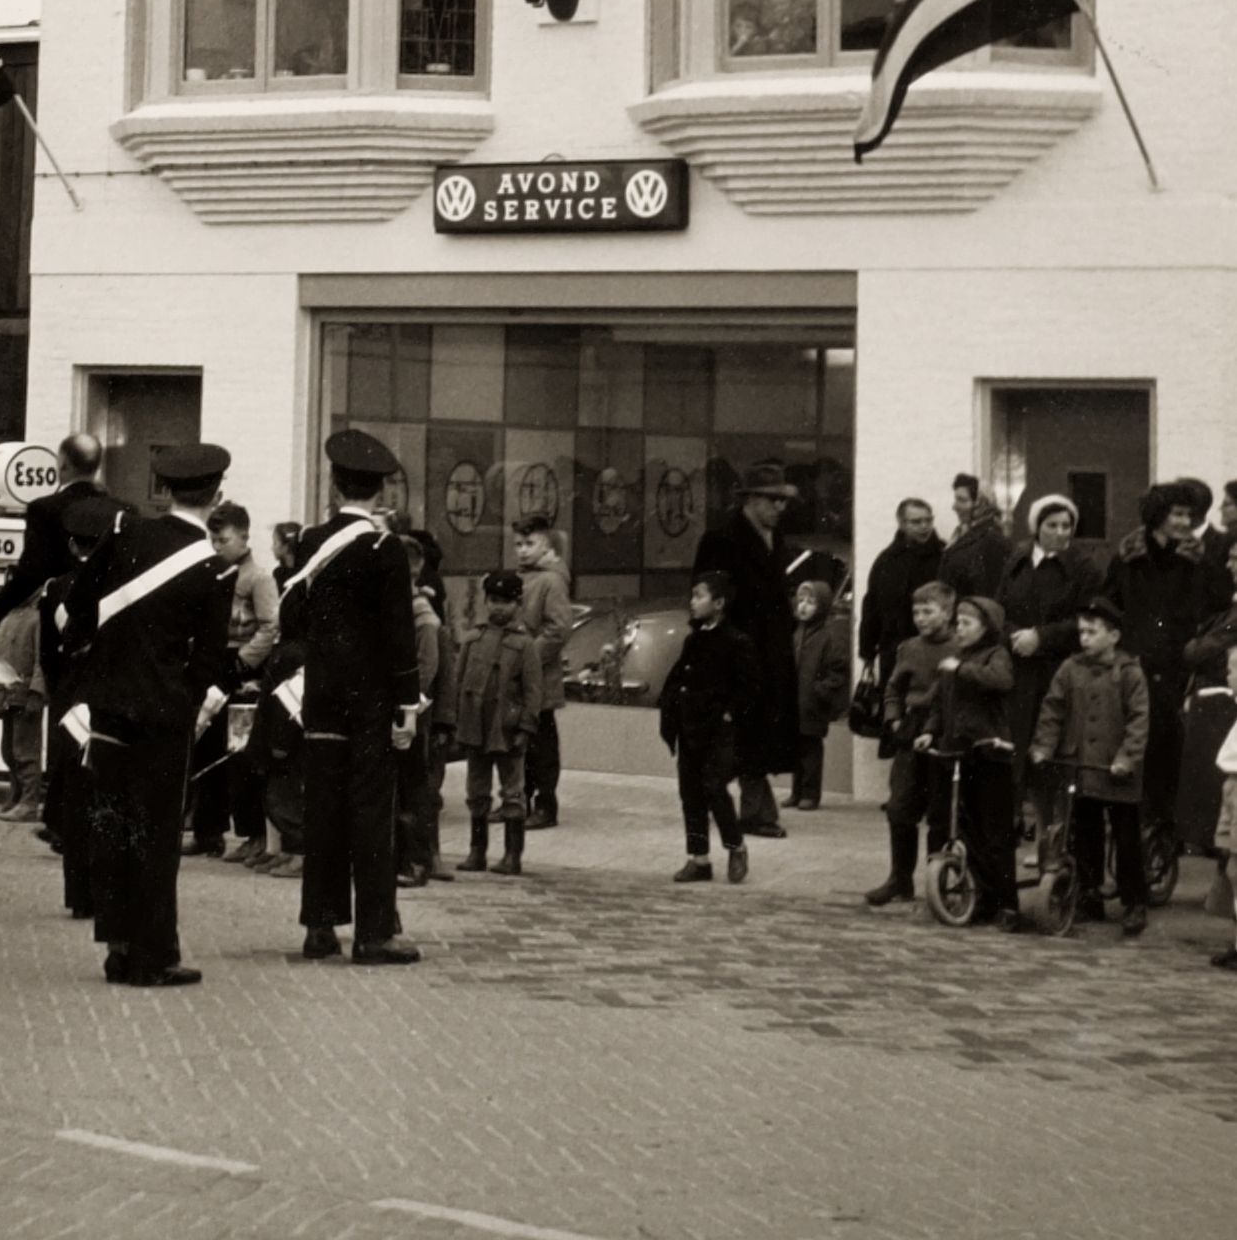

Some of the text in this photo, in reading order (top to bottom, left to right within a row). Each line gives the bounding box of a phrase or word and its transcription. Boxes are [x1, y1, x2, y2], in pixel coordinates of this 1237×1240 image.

[496, 171, 601, 195] AVOND
[626, 170, 668, 217] VW
[437, 176, 476, 221] VW
[483, 197, 617, 222] SERVICE
[14, 461, 57, 487] Esso
